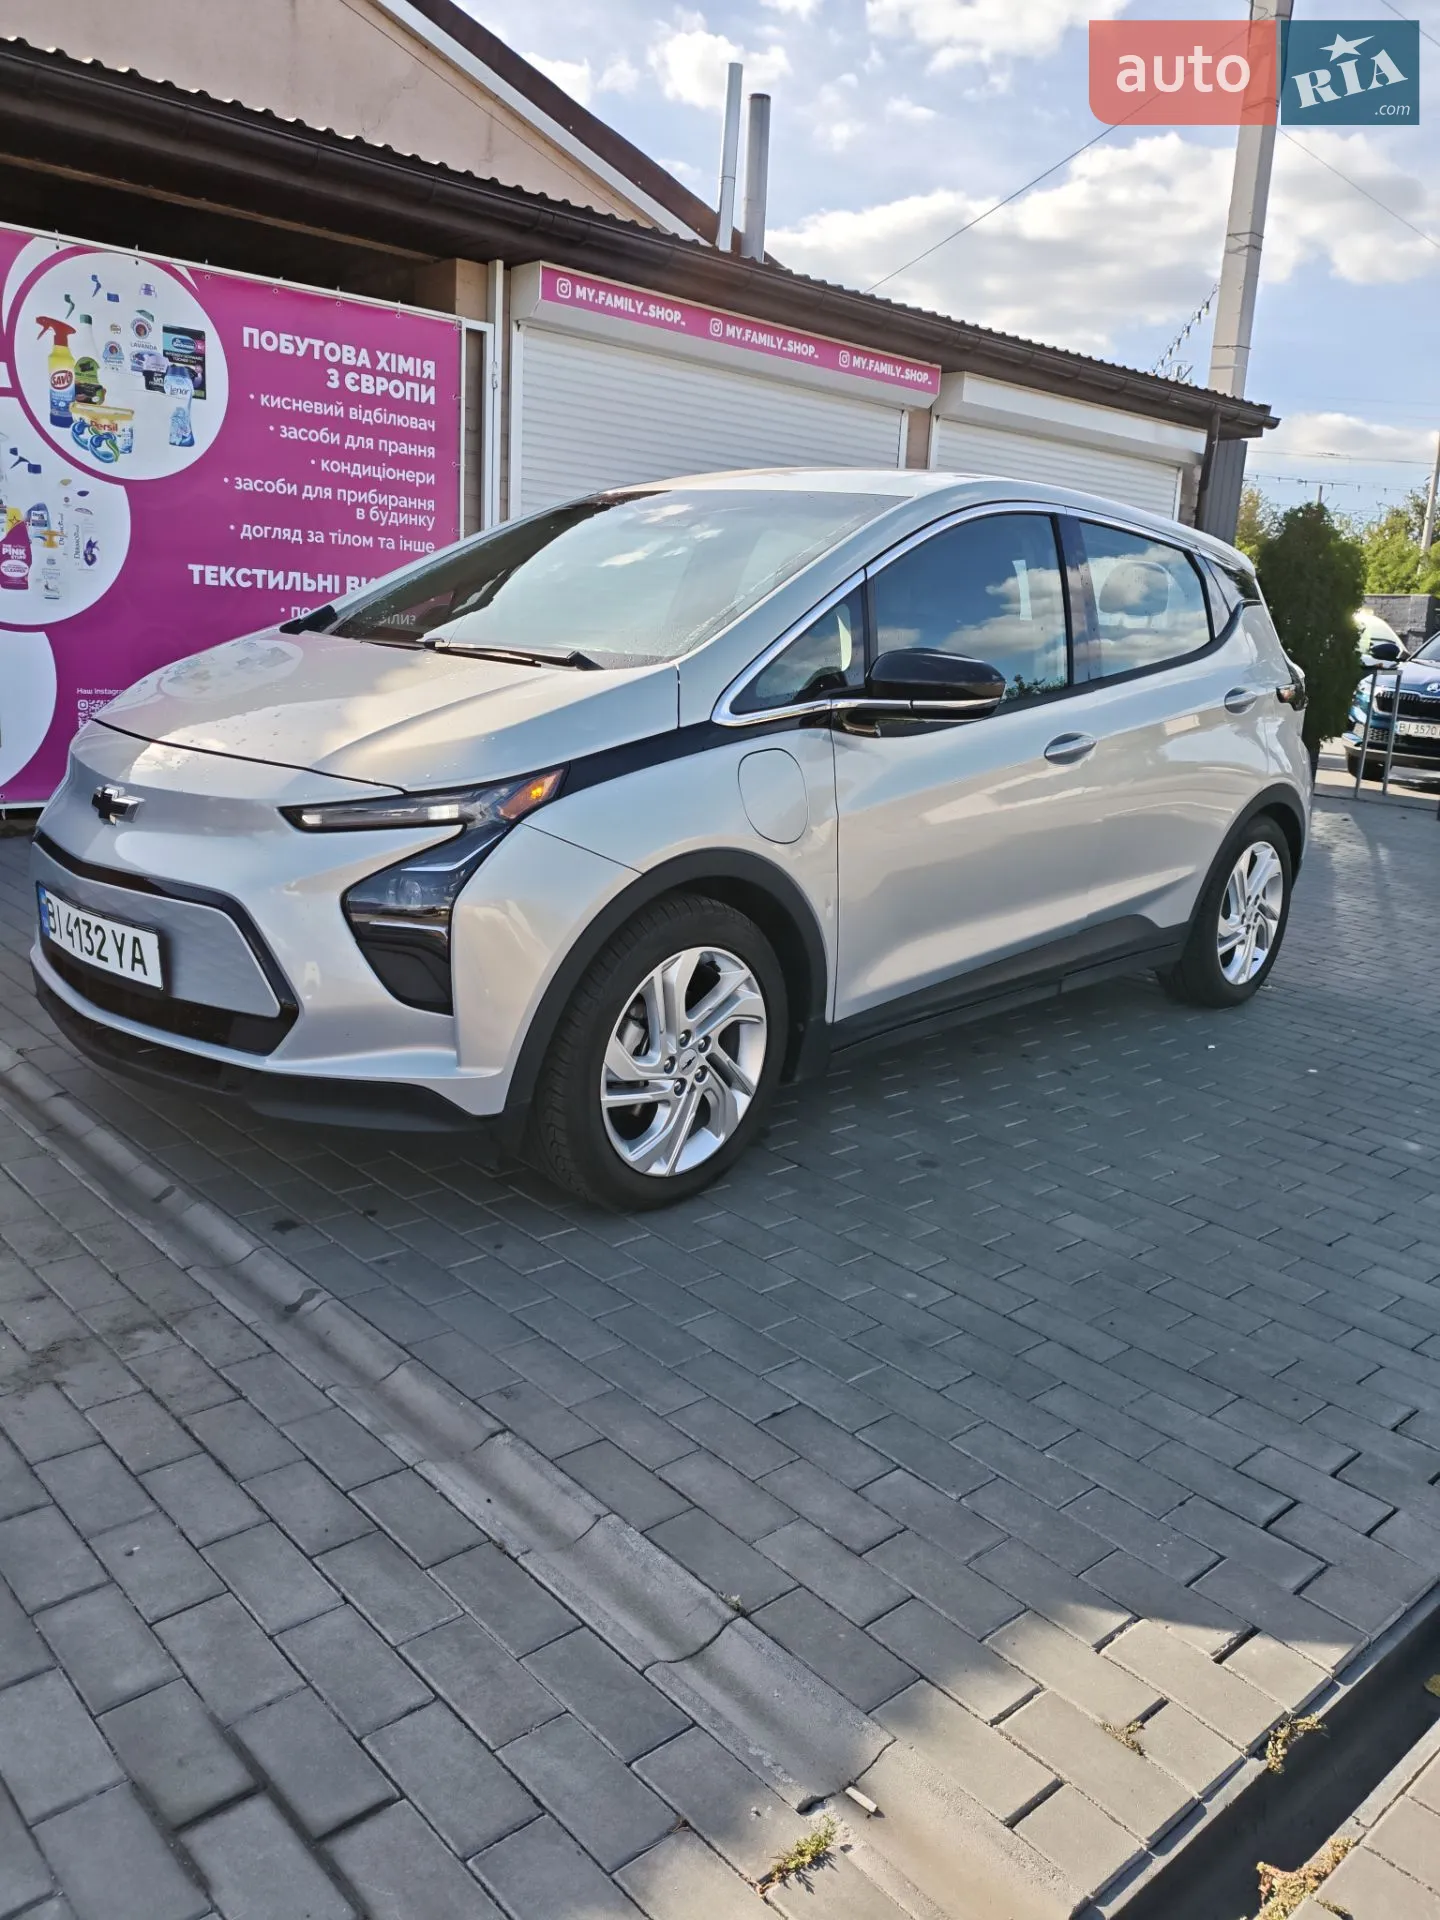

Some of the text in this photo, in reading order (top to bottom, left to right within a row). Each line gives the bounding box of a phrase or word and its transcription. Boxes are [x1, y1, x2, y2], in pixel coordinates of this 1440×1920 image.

[242, 326, 436, 380] ПОБУТОВА ХІМІЯ
[344, 371, 436, 405] ЄВРОПИ
[260, 393, 436, 432] кисневий відбілювач
[279, 424, 436, 459] засоби для прання
[320, 458, 436, 487] кондиціонери
[234, 476, 436, 512] засоби для прибирання
[356, 505, 436, 531] в будинку
[240, 523, 436, 554] догляд за тілом та інше
[187, 563, 340, 594] ТЕКСТИЛЬНІ
[46, 897, 148, 976] BI 4132 YA
